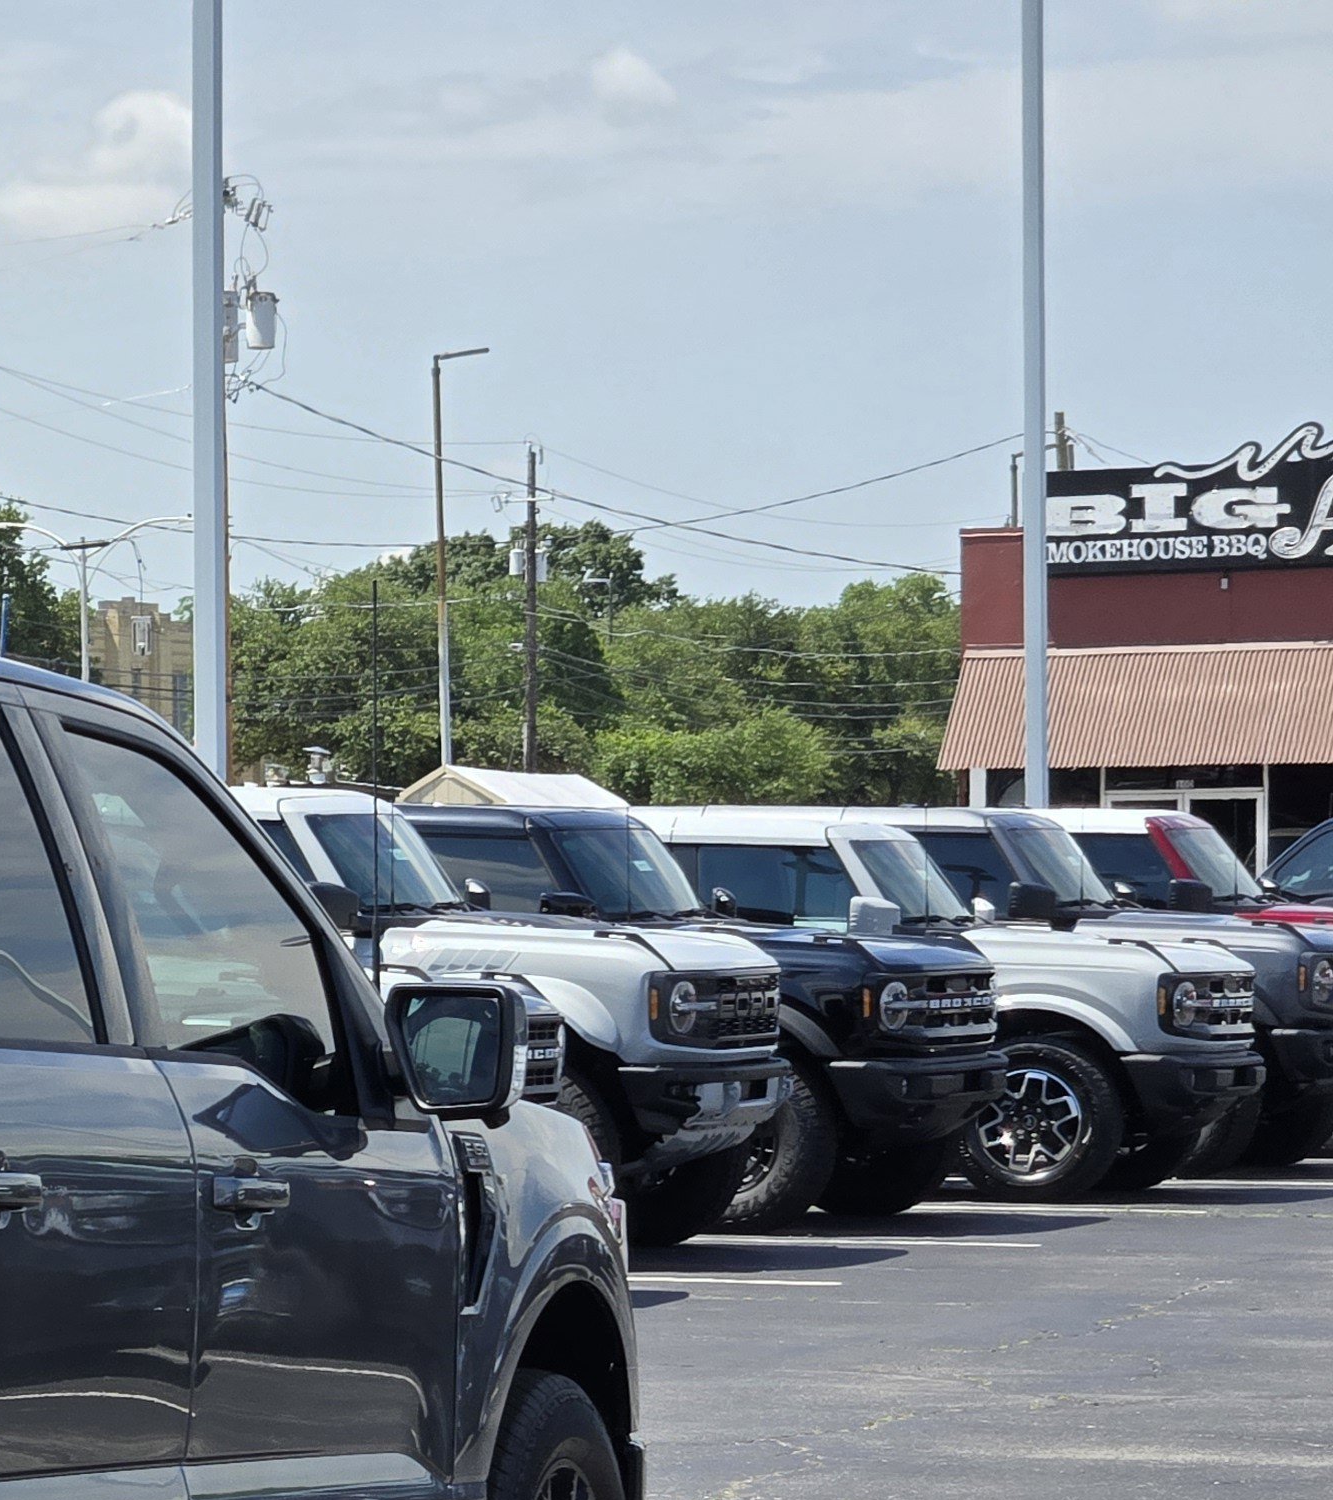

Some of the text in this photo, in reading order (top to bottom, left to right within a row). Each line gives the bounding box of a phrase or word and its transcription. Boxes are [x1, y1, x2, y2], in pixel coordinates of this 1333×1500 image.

[1046, 482, 1291, 537] BIG
[1046, 533, 1268, 564] MOKEHOUSE BBQ
